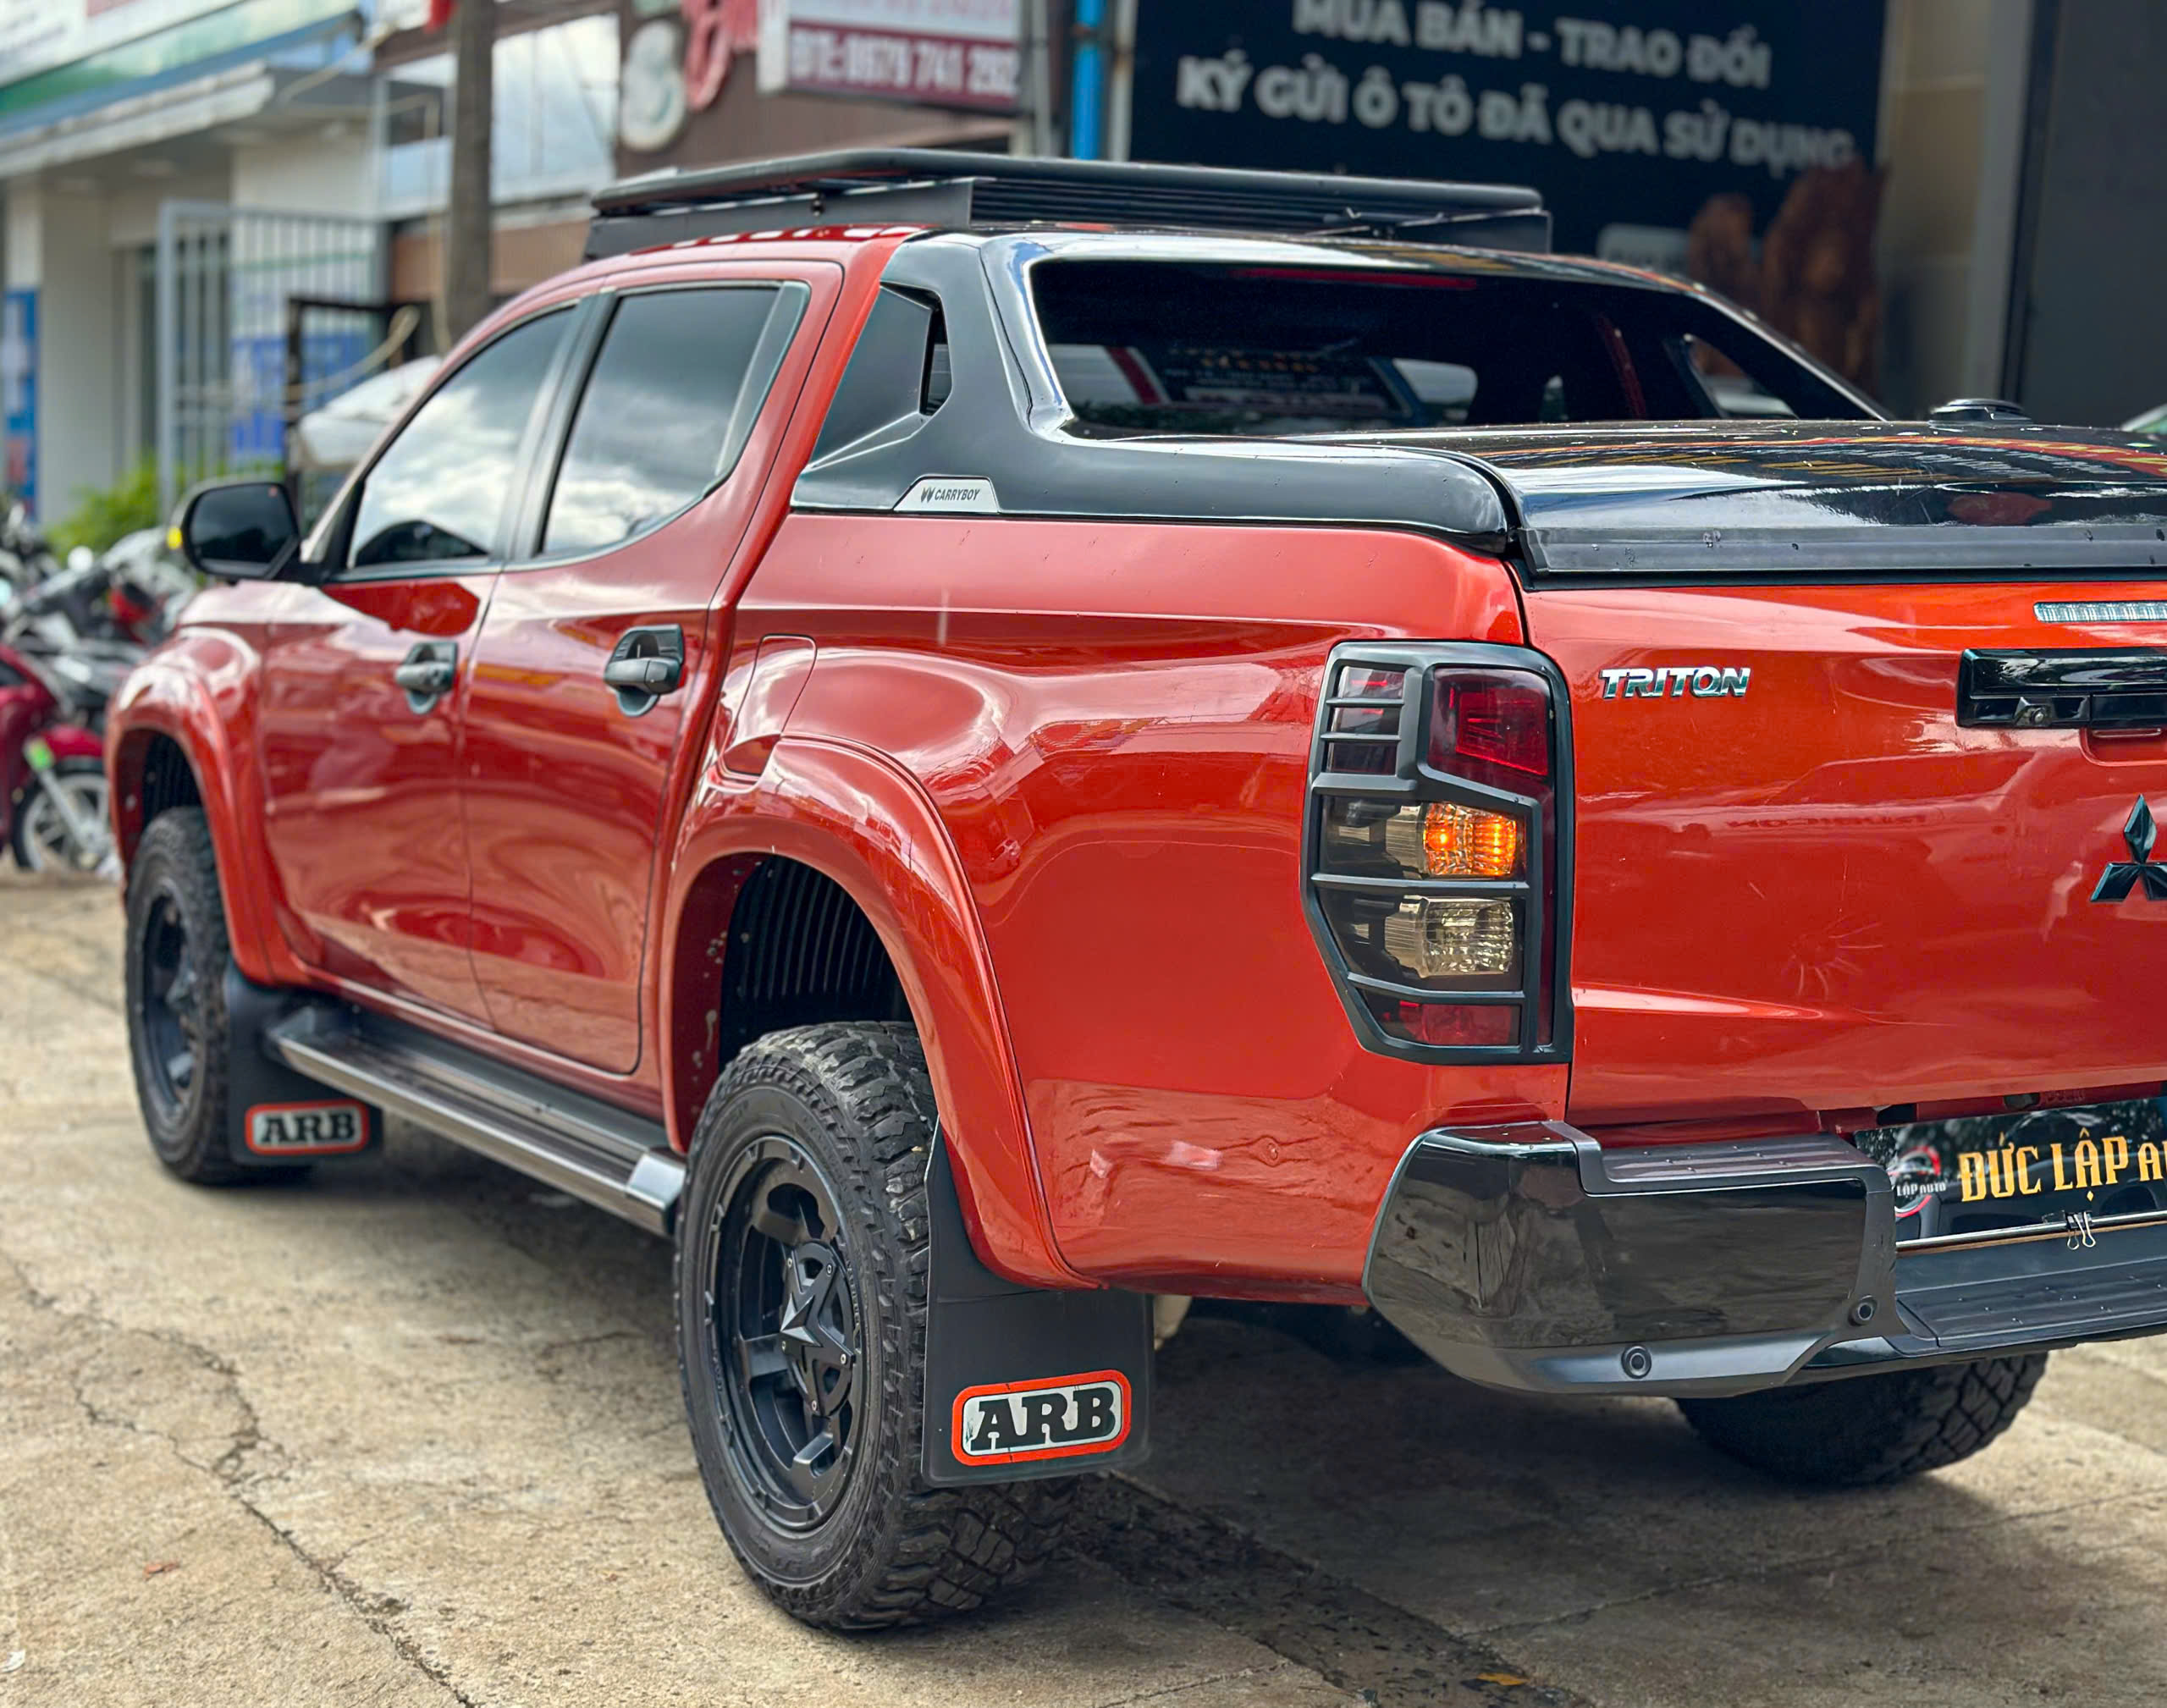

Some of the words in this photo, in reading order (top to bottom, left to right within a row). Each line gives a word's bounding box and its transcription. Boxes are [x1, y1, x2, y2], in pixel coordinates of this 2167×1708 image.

[1292, 0, 1410, 46] MUA
[1415, 2, 1522, 58] BÁN
[1556, 17, 1682, 76] TRAO
[1176, 47, 1253, 113] KÝ
[1254, 52, 1349, 124] GỬI
[1354, 64, 1398, 129] Ô
[1401, 74, 1474, 136] TÔ
[1477, 82, 1552, 144] ĐÃ
[1556, 99, 1659, 158] QUA
[1729, 118, 1856, 178] DỤNG
[935, 488, 980, 502] CARRYBOY
[1600, 666, 1751, 699] TRITON
[262, 1110, 355, 1143] ARB
[1957, 1132, 2042, 1202] ĐỨC
[2050, 1127, 2129, 1202] LẬP
[2137, 1141, 2167, 1182] A
[970, 1386, 1117, 1452] ARB
